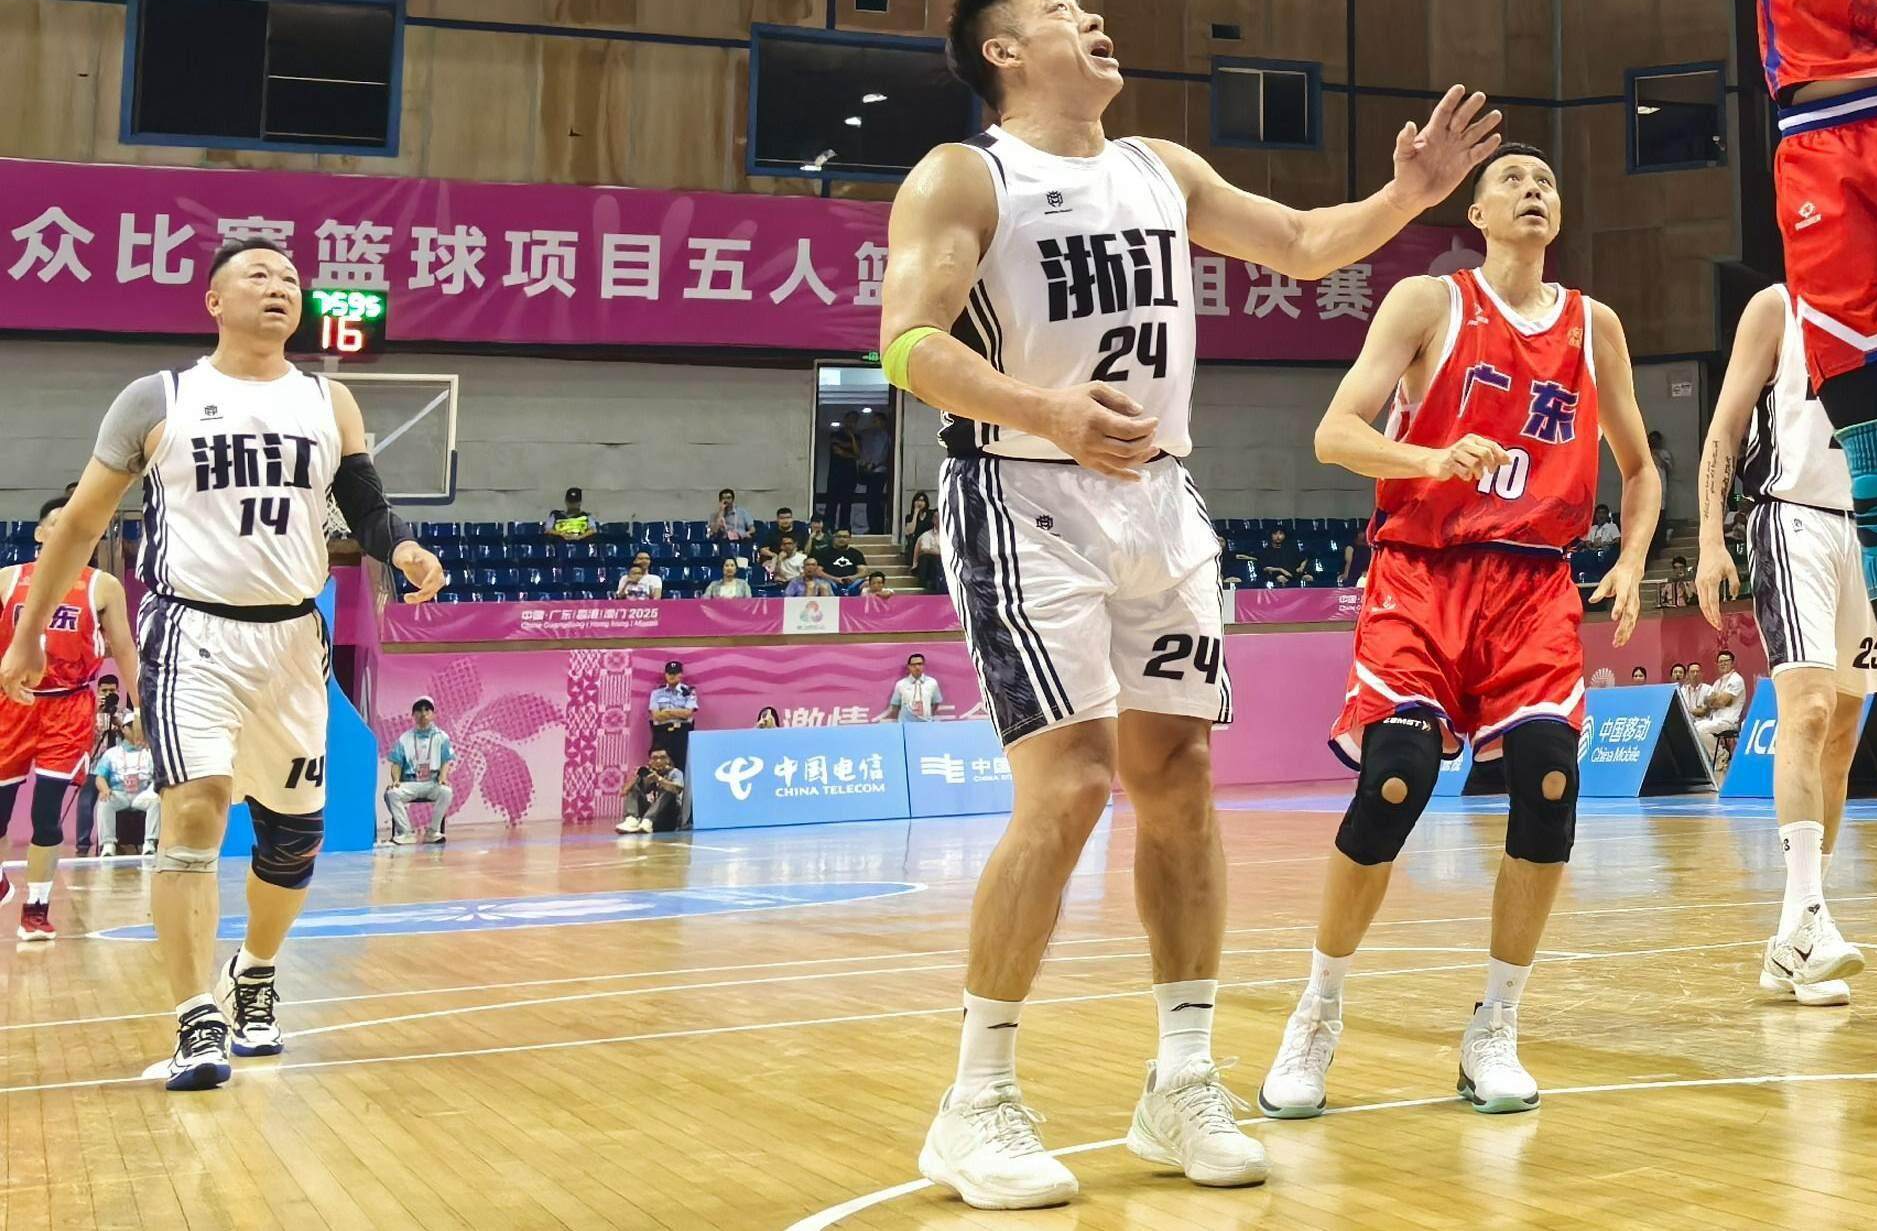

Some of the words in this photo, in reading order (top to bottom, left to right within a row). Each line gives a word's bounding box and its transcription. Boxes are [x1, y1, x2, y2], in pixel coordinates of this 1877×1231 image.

[1036, 228, 1179, 323] 浙江
[1090, 321, 1168, 383] 24
[1457, 360, 1580, 445] 广东
[190, 432, 319, 493] 浙江
[240, 497, 291, 537] 14
[1143, 633, 1221, 685] 24
[1599, 715, 1652, 743] 中国移动
[1744, 718, 1779, 755] IC
[284, 755, 325, 789] 14
[773, 752, 885, 787] 中国电信
[1591, 745, 1614, 763] China
[1613, 743, 1642, 763] Mobile
[774, 785, 820, 798] CHINA
[822, 782, 886, 796] TELECOM
